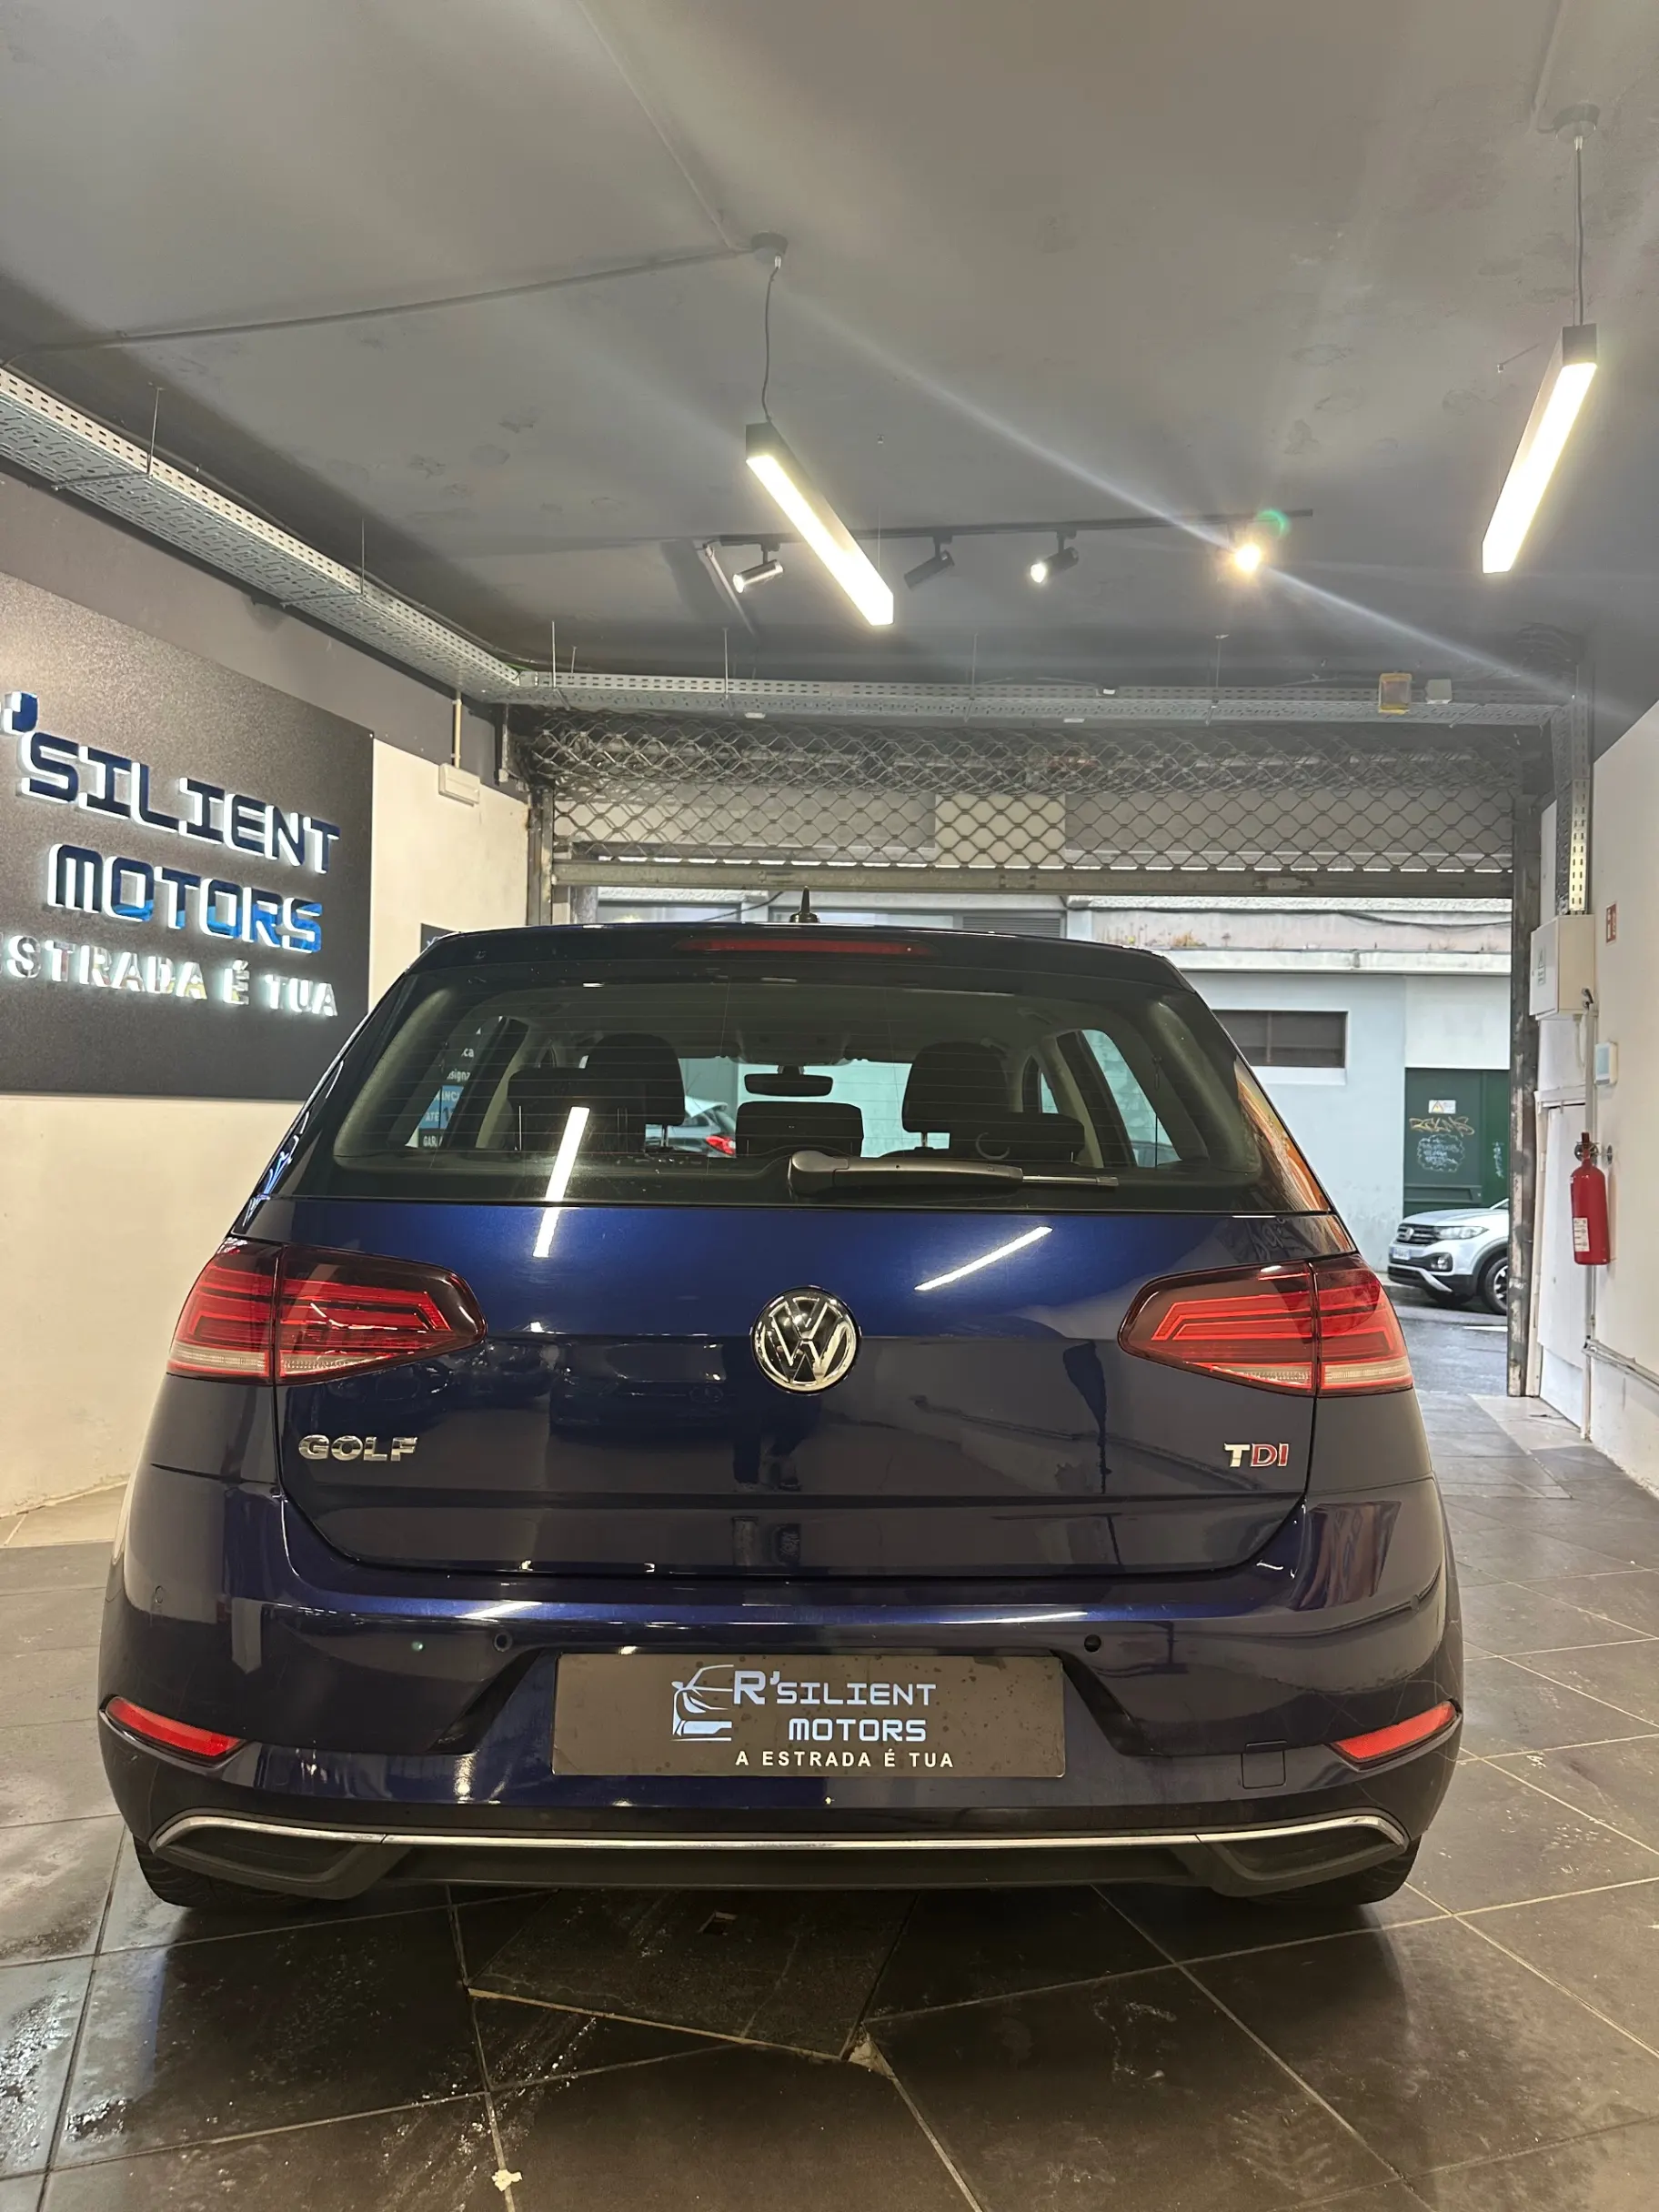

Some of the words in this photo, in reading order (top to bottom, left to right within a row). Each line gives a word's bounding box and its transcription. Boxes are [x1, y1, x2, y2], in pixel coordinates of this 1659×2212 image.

[48, 844, 322, 952] MOTORS
[0, 932, 207, 1000] STRADA
[223, 960, 249, 1005] É
[265, 974, 337, 1016] TUA
[298, 1434, 418, 1462] GOLF
[1223, 1443, 1289, 1467] TDI
[733, 1670, 937, 1705] R'SILIENT
[789, 1718, 926, 1742] MOTORS
[735, 1750, 749, 1766] A
[762, 1751, 871, 1767] ESTRADA
[884, 1748, 895, 1767] É
[909, 1752, 953, 1768] TUA
